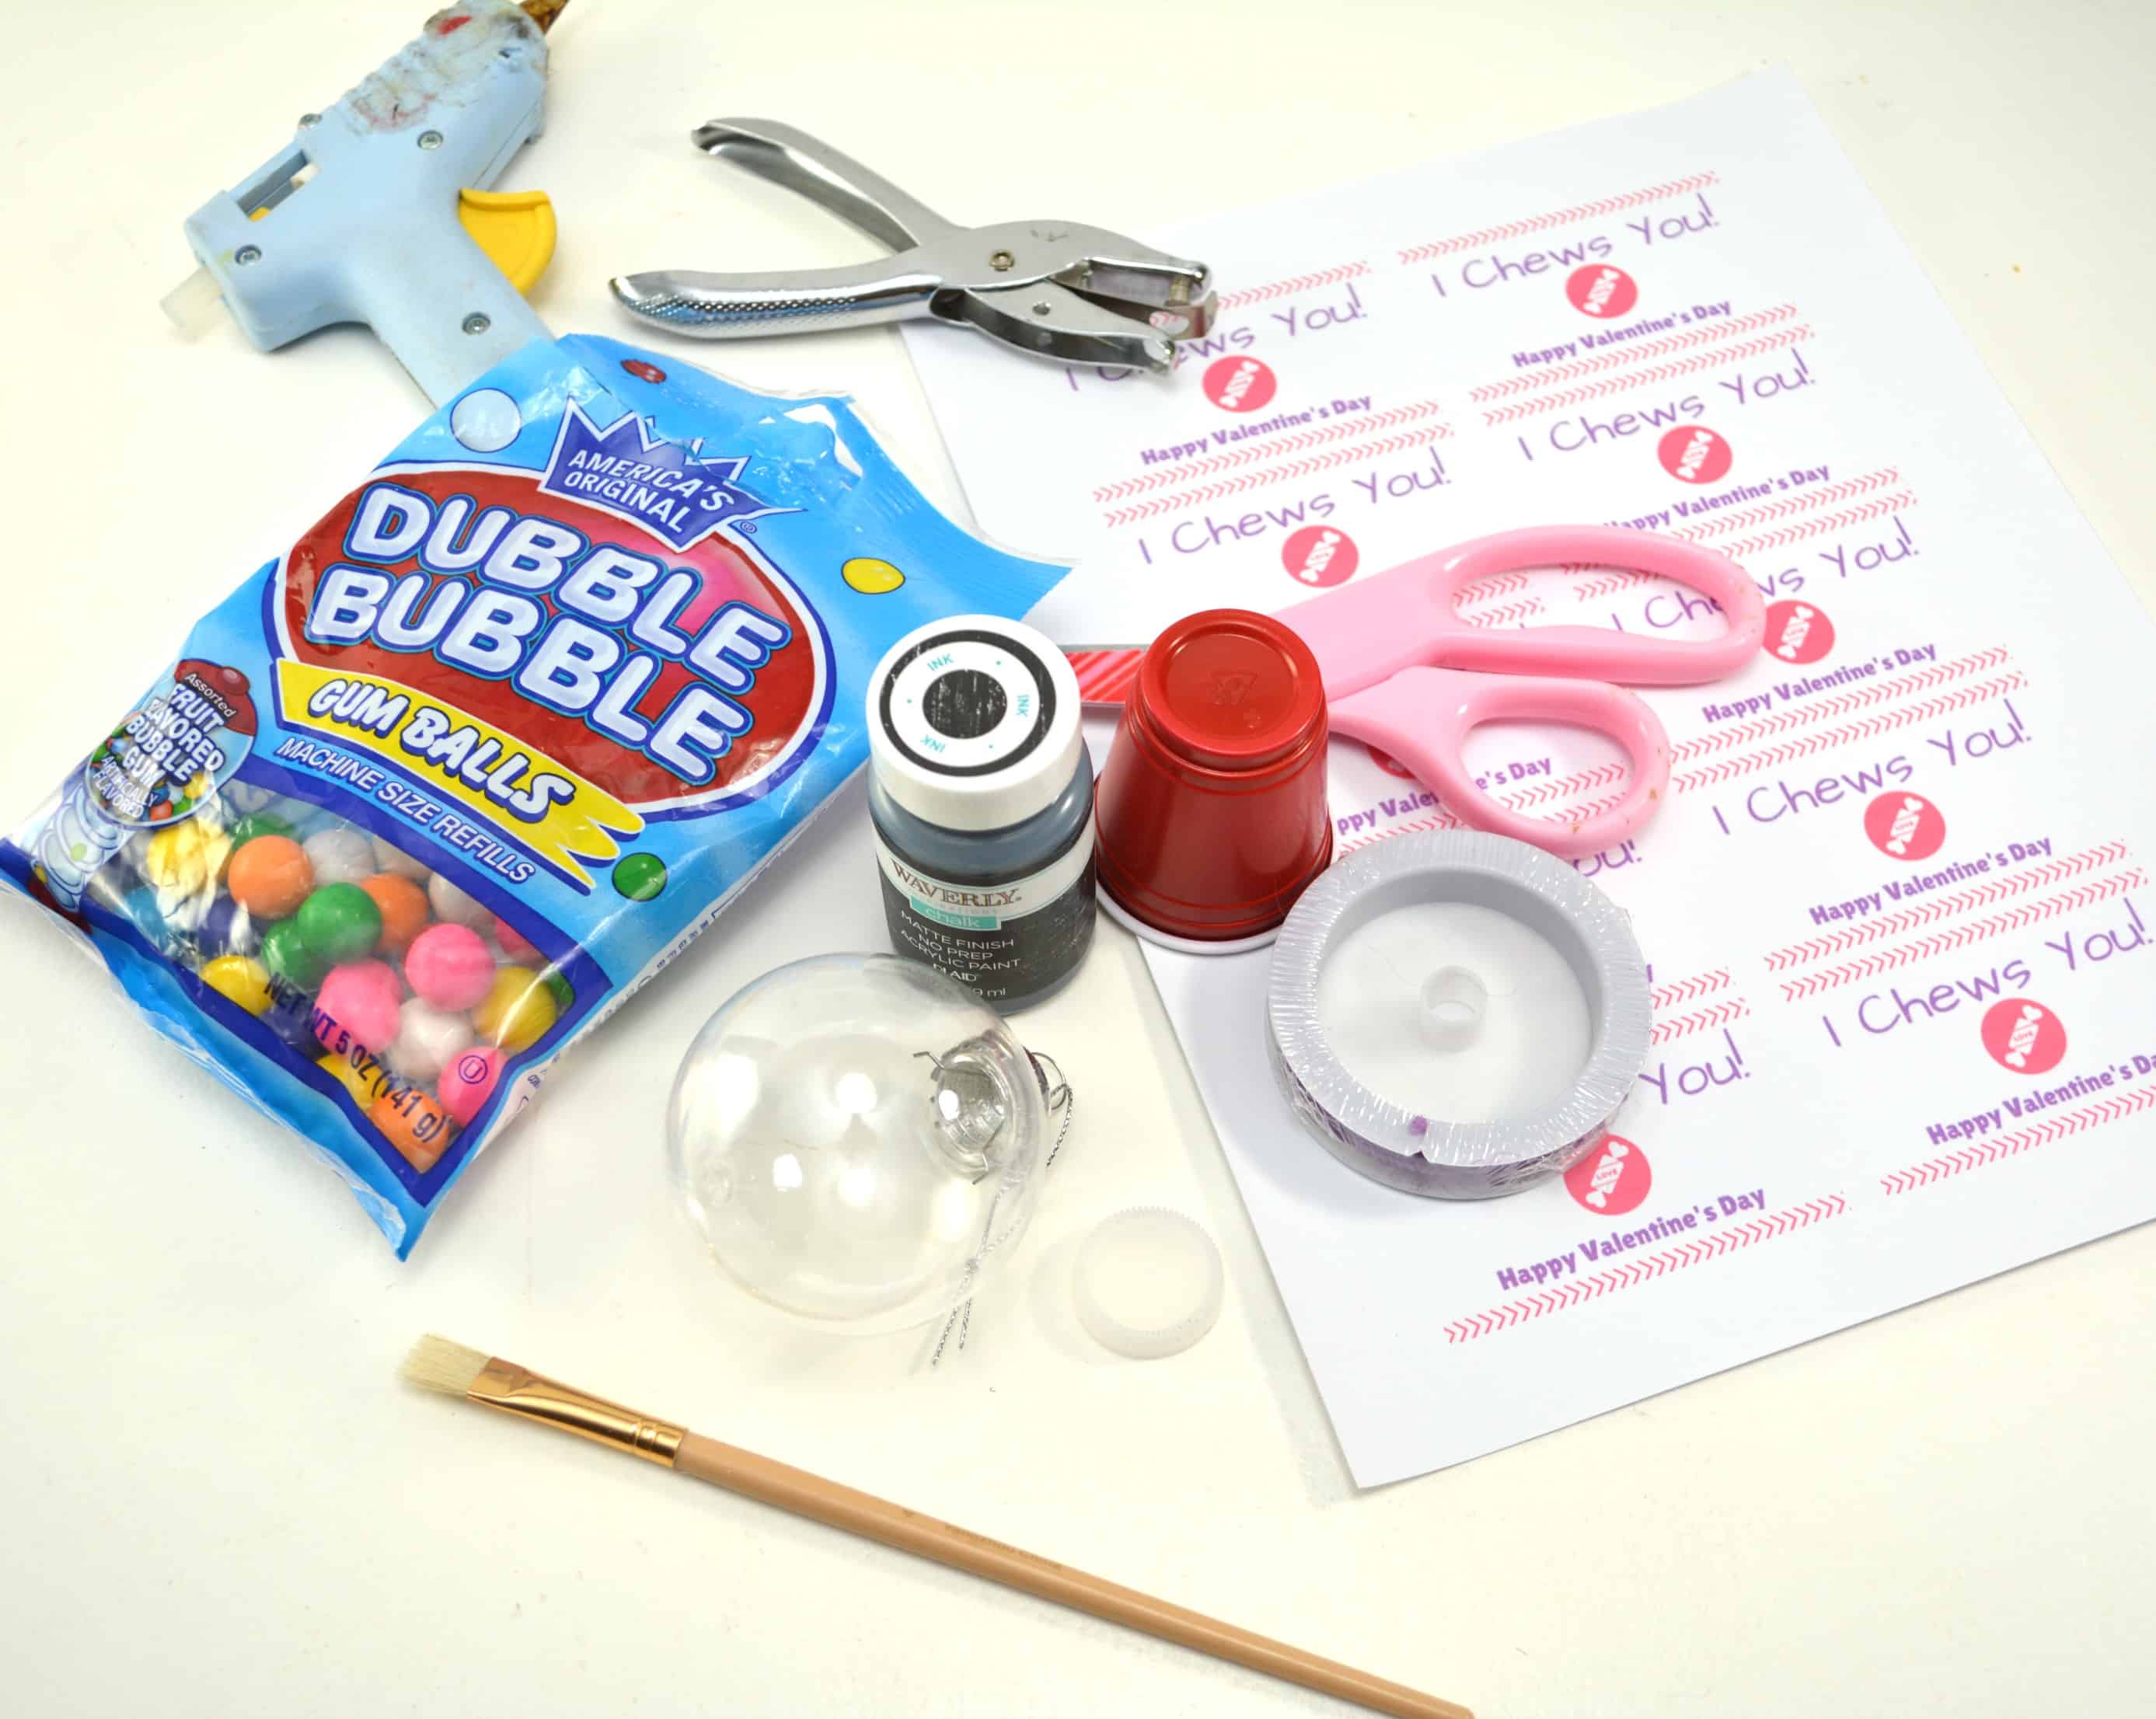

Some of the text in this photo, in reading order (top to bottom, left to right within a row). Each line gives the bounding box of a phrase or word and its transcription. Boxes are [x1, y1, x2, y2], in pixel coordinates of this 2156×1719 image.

[1432, 193, 1719, 298] I Chews You!
[1271, 282, 1367, 336] You!
[1512, 301, 1732, 368] Happy Valentine's Day
[1139, 396, 1371, 465] Happy Valentine's Day
[1517, 347, 1816, 461] I Chews You!
[565, 471, 696, 534] ORIGINAL
[567, 449, 735, 513] AMERICA'S
[1138, 445, 1452, 564] I Chews You!
[1671, 474, 1792, 518] Valentine's
[1789, 465, 1830, 486] Day
[1818, 515, 1920, 578] You!
[345, 482, 791, 693] DUBBLE
[186, 672, 237, 717] Assorted
[305, 561, 751, 788] BUBBLE
[927, 653, 954, 672] INK
[1701, 643, 1936, 724] Happy Valentine's Day
[169, 684, 224, 732] FRUIT
[1017, 695, 1030, 717] INK
[122, 746, 166, 790] GUM
[127, 717, 199, 781] BUBBLE
[309, 679, 575, 822] GUM BALLS
[920, 734, 946, 753] INK
[1506, 758, 1551, 782] Day
[1711, 698, 2032, 835] I Chews You!
[92, 769, 145, 818] FLAVORED
[279, 742, 537, 883] MACHINE SIZE REFILLS
[1808, 837, 2052, 926] Happy Valentine's Day
[901, 909, 953, 946] MATTE
[956, 938, 1014, 950] FINISH
[901, 929, 1021, 971] ACRYLIC PAINT
[919, 933, 993, 961] NO PREP
[926, 909, 981, 928] chalk
[987, 988, 1006, 997] ml
[1822, 897, 2154, 1048] I Chews You!
[263, 971, 307, 1014] NET
[335, 1030, 351, 1055] 5
[351, 1045, 381, 1082] OZ
[413, 1111, 449, 1143] g)
[1638, 1027, 1751, 1105] You!
[1925, 1108, 2003, 1145] Happy
[2002, 1060, 2133, 1118] Valentine's
[1496, 1188, 1766, 1291] Happy Valentine's Day
